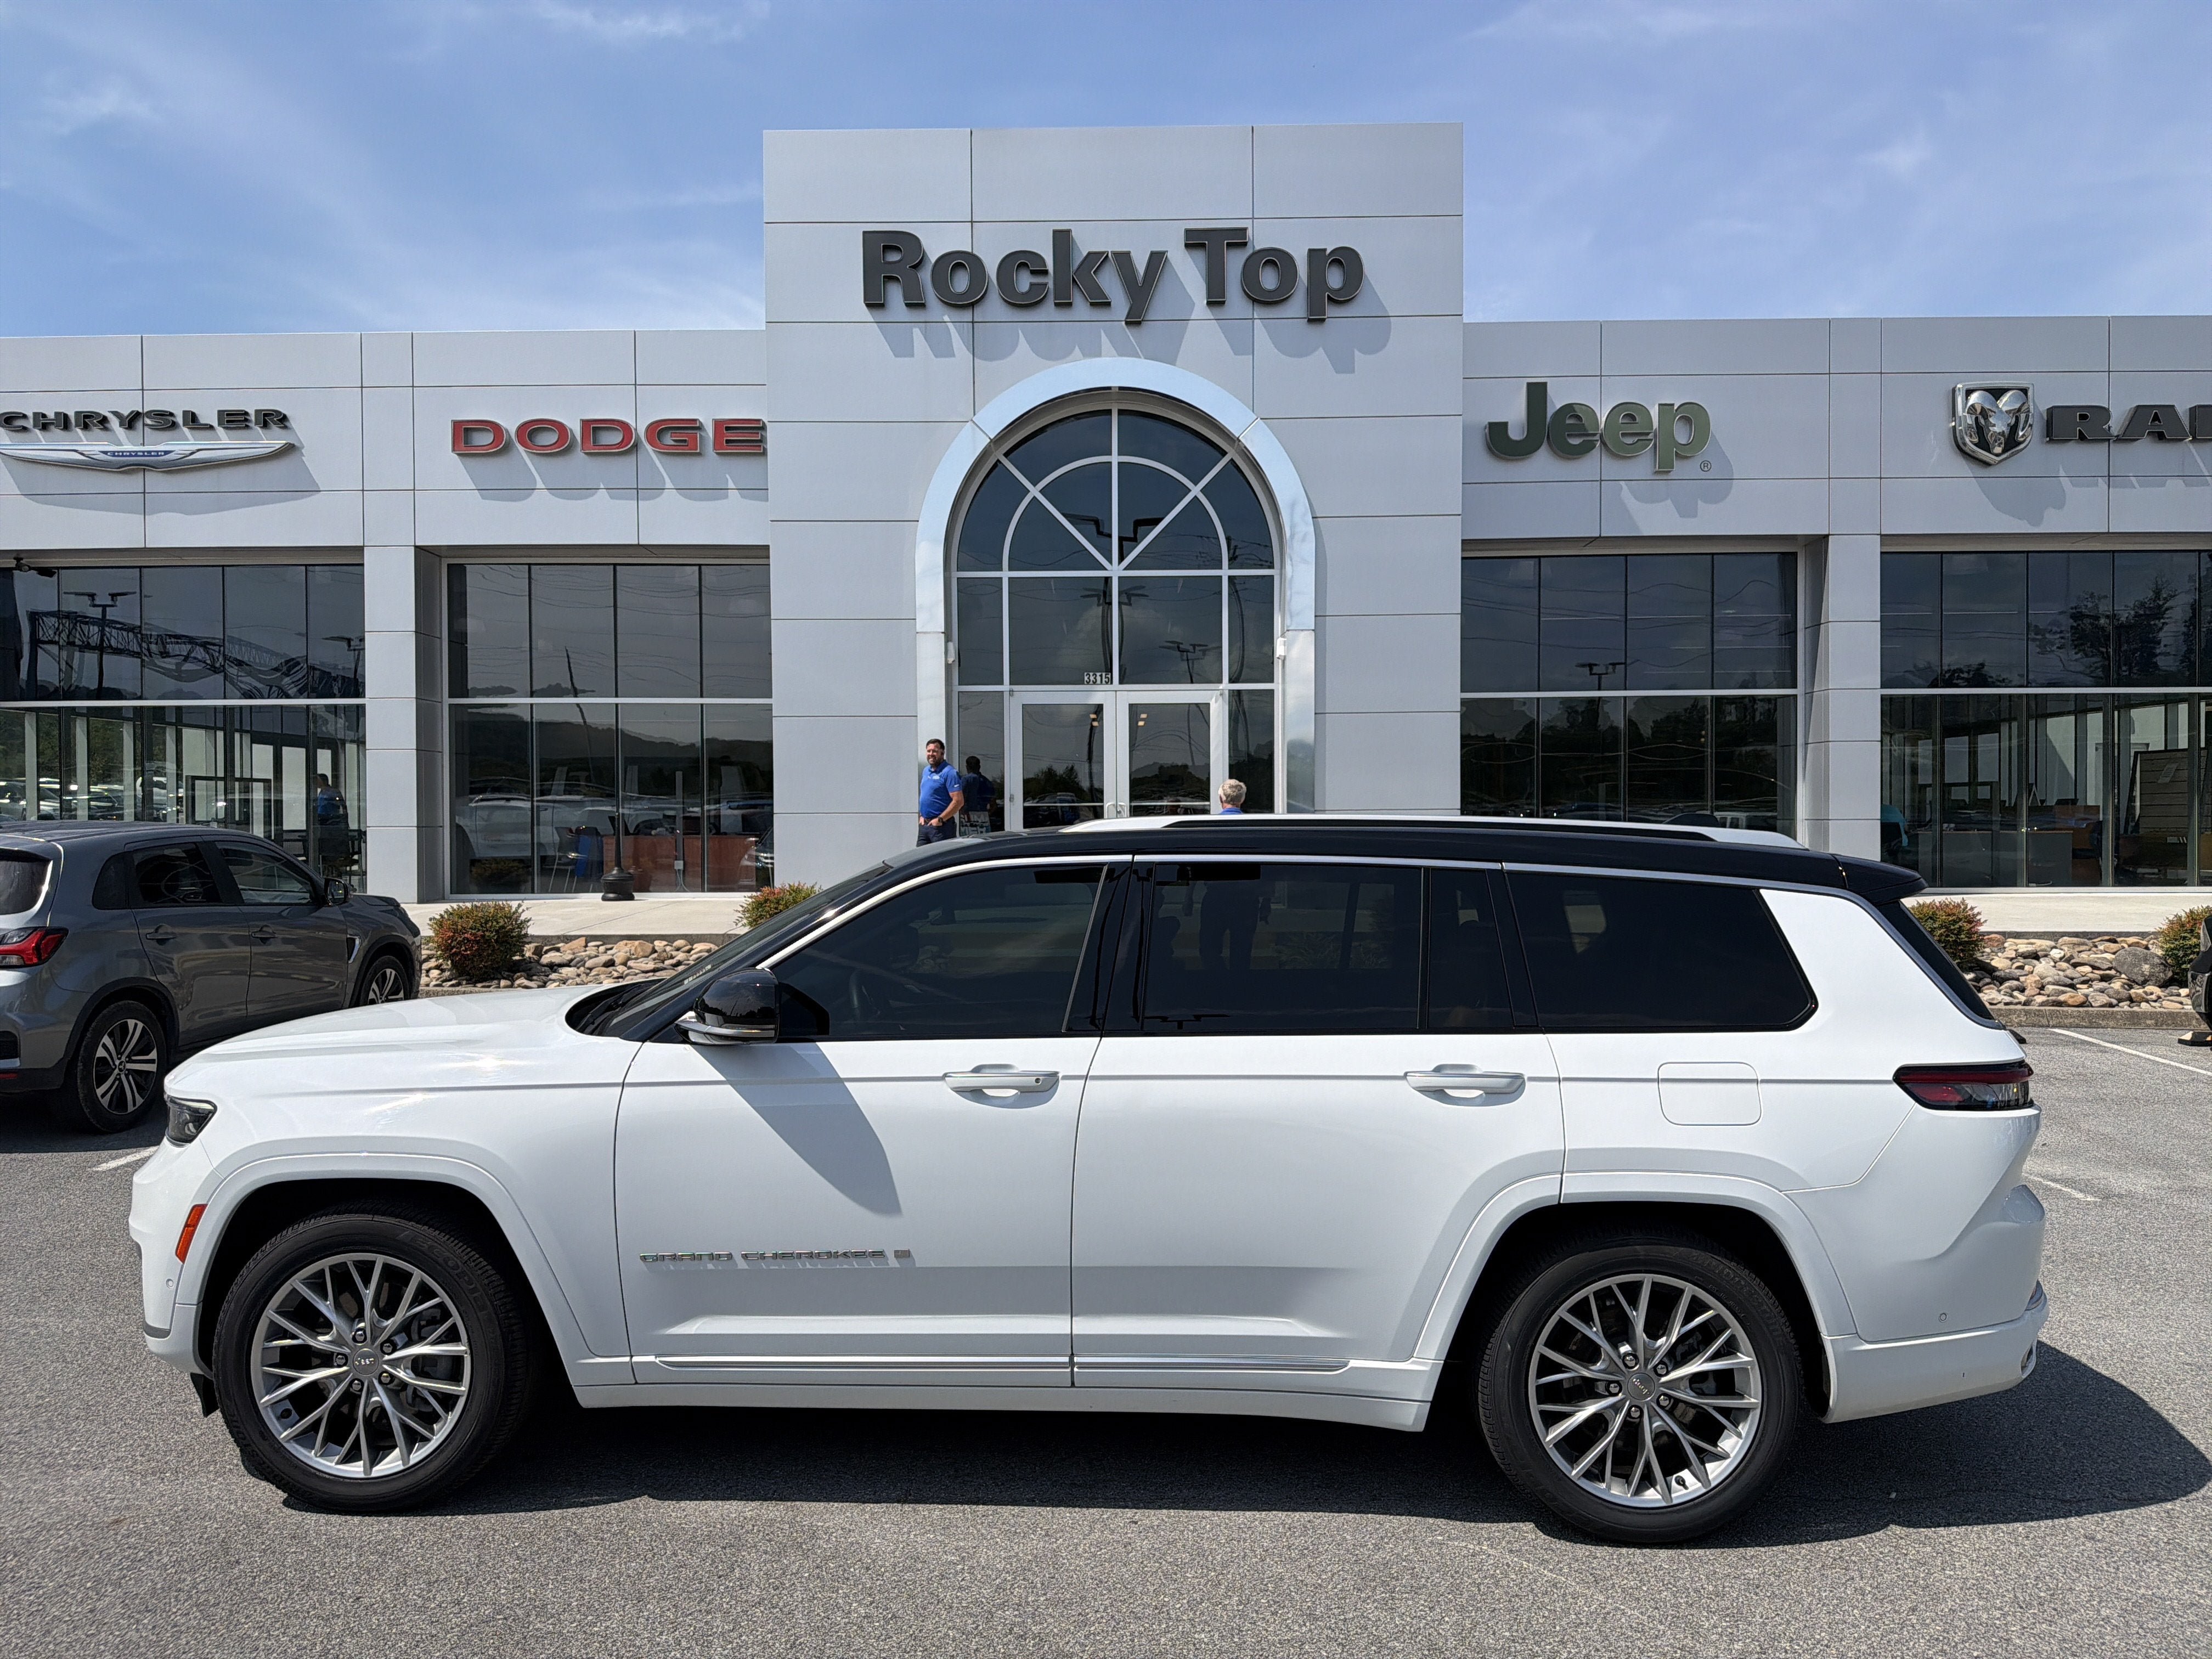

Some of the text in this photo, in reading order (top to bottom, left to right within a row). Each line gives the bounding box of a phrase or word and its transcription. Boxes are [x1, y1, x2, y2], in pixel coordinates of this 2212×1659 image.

[862, 227, 1365, 324] Rocky Top
[0, 409, 287, 431] CHRYSLER
[450, 418, 766, 454] DODGE
[1485, 381, 1711, 473] Jeep
[2046, 404, 2212, 441] RA
[1085, 673, 1110, 684] 3315
[640, 1251, 733, 1262] GRAND
[741, 1249, 885, 1260] CHEROKEE
